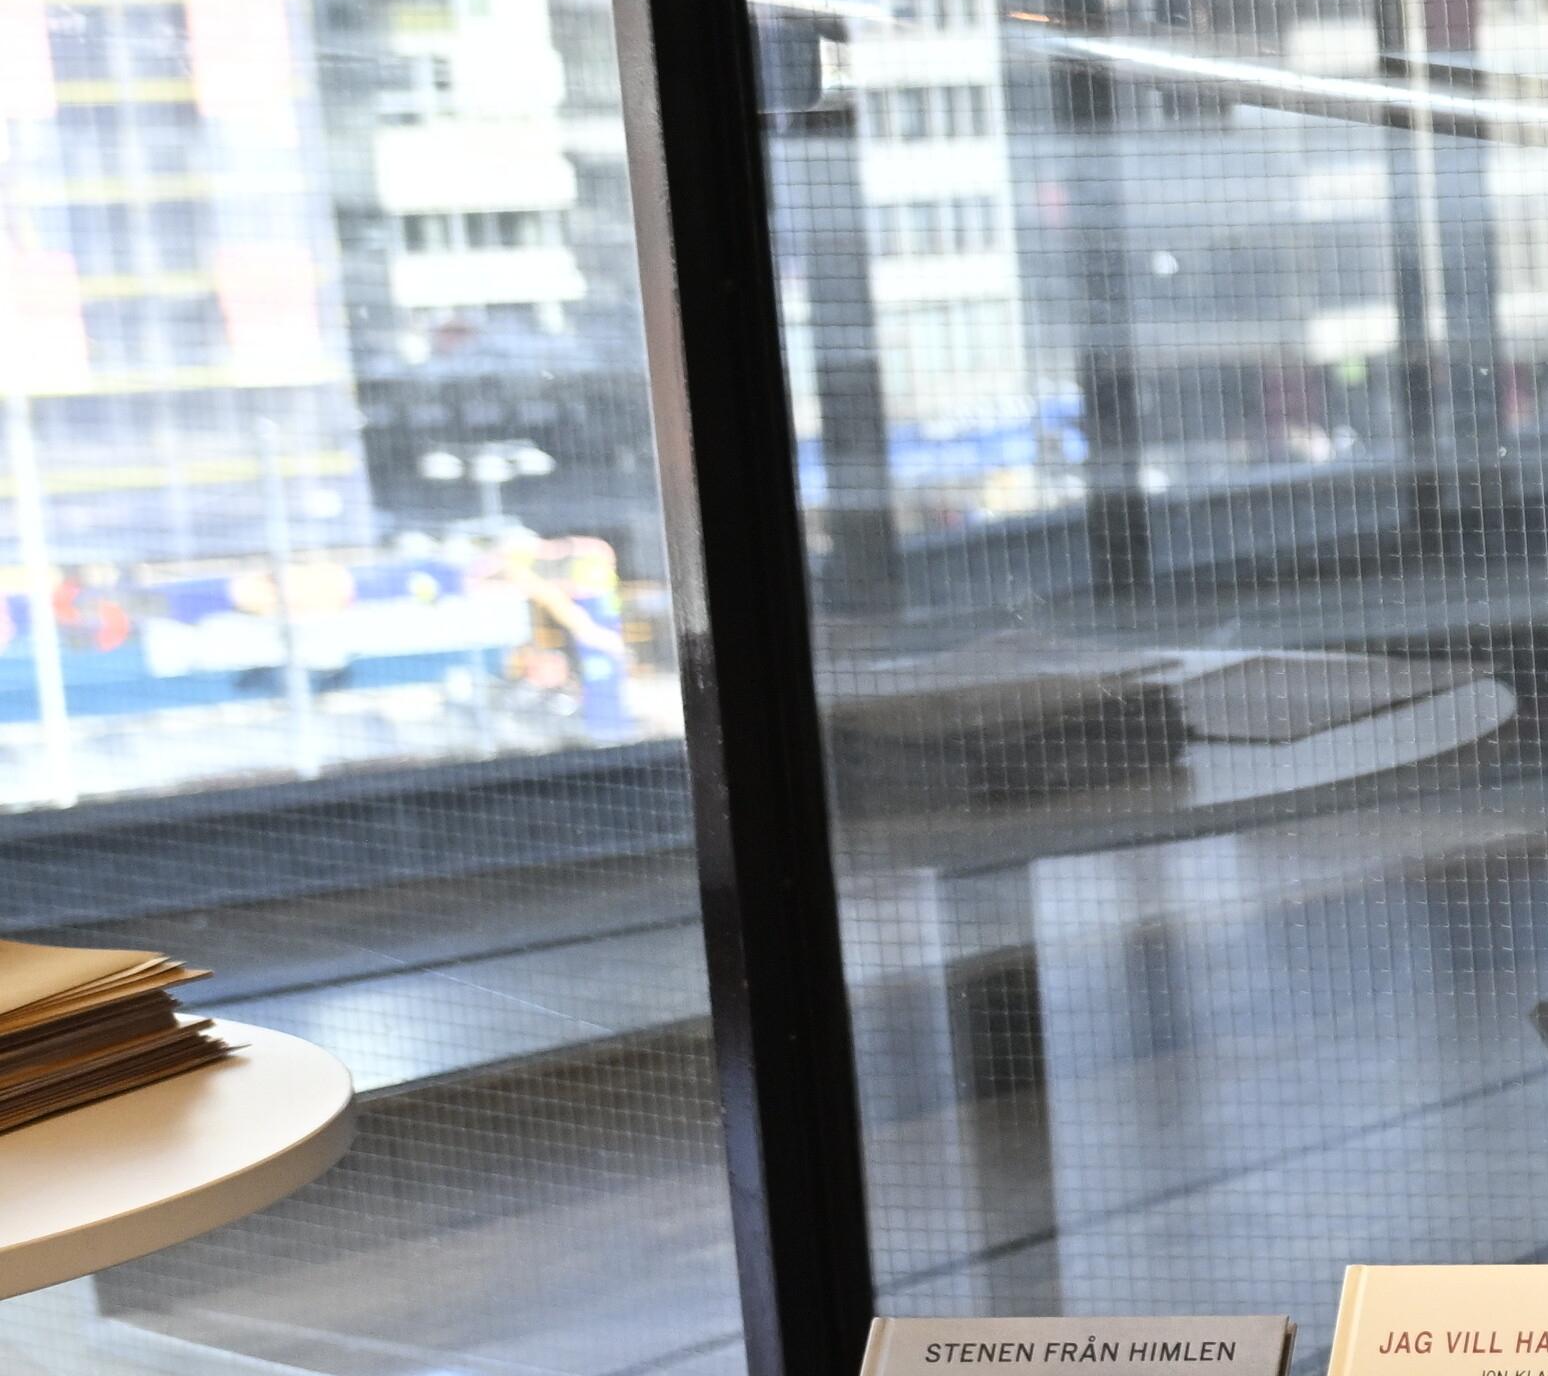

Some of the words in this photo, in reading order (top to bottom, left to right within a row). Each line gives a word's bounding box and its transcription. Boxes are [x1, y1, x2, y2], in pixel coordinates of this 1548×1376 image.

[925, 1342, 1035, 1363] STENEN
[1043, 1335, 1120, 1363] FRÅN
[1128, 1341, 1236, 1362] HIMLEN
[1379, 1330, 1433, 1355] JAG
[1446, 1331, 1503, 1354] VILL
